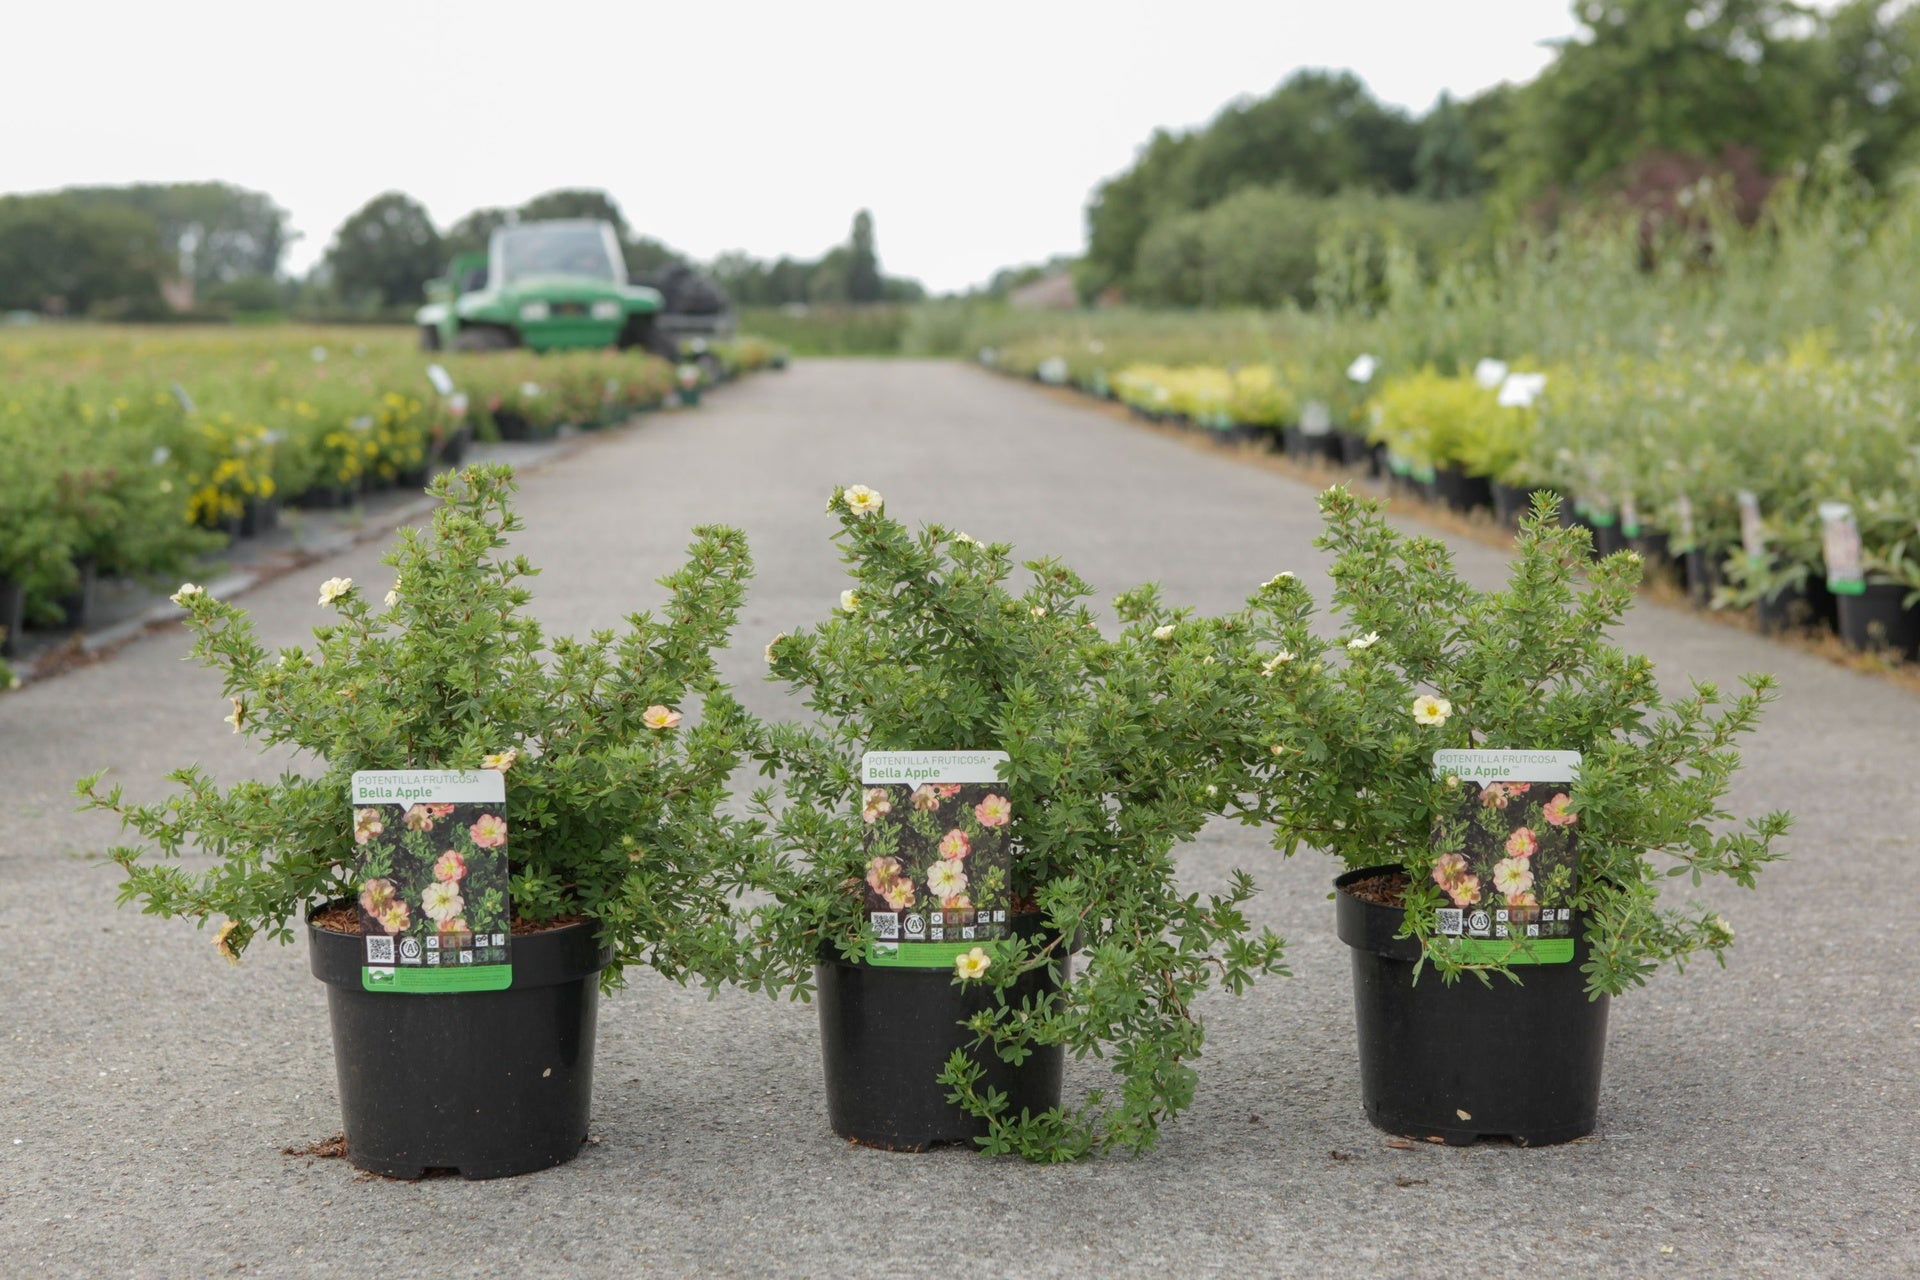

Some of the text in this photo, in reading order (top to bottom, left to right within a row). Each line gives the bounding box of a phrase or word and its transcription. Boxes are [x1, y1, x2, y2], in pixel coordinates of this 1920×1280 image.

[868, 756, 986, 766] POTENTILLA FRUTICOSA
[1439, 754, 1557, 764] POTENTILLA FRUTICOSA
[869, 768, 902, 778] Bella
[904, 767, 940, 780] Apple
[1474, 765, 1510, 778] Apple
[358, 774, 479, 785] POTENTILLA FRUTICOSA
[359, 787, 392, 798] Bella
[395, 786, 432, 799] Apple
